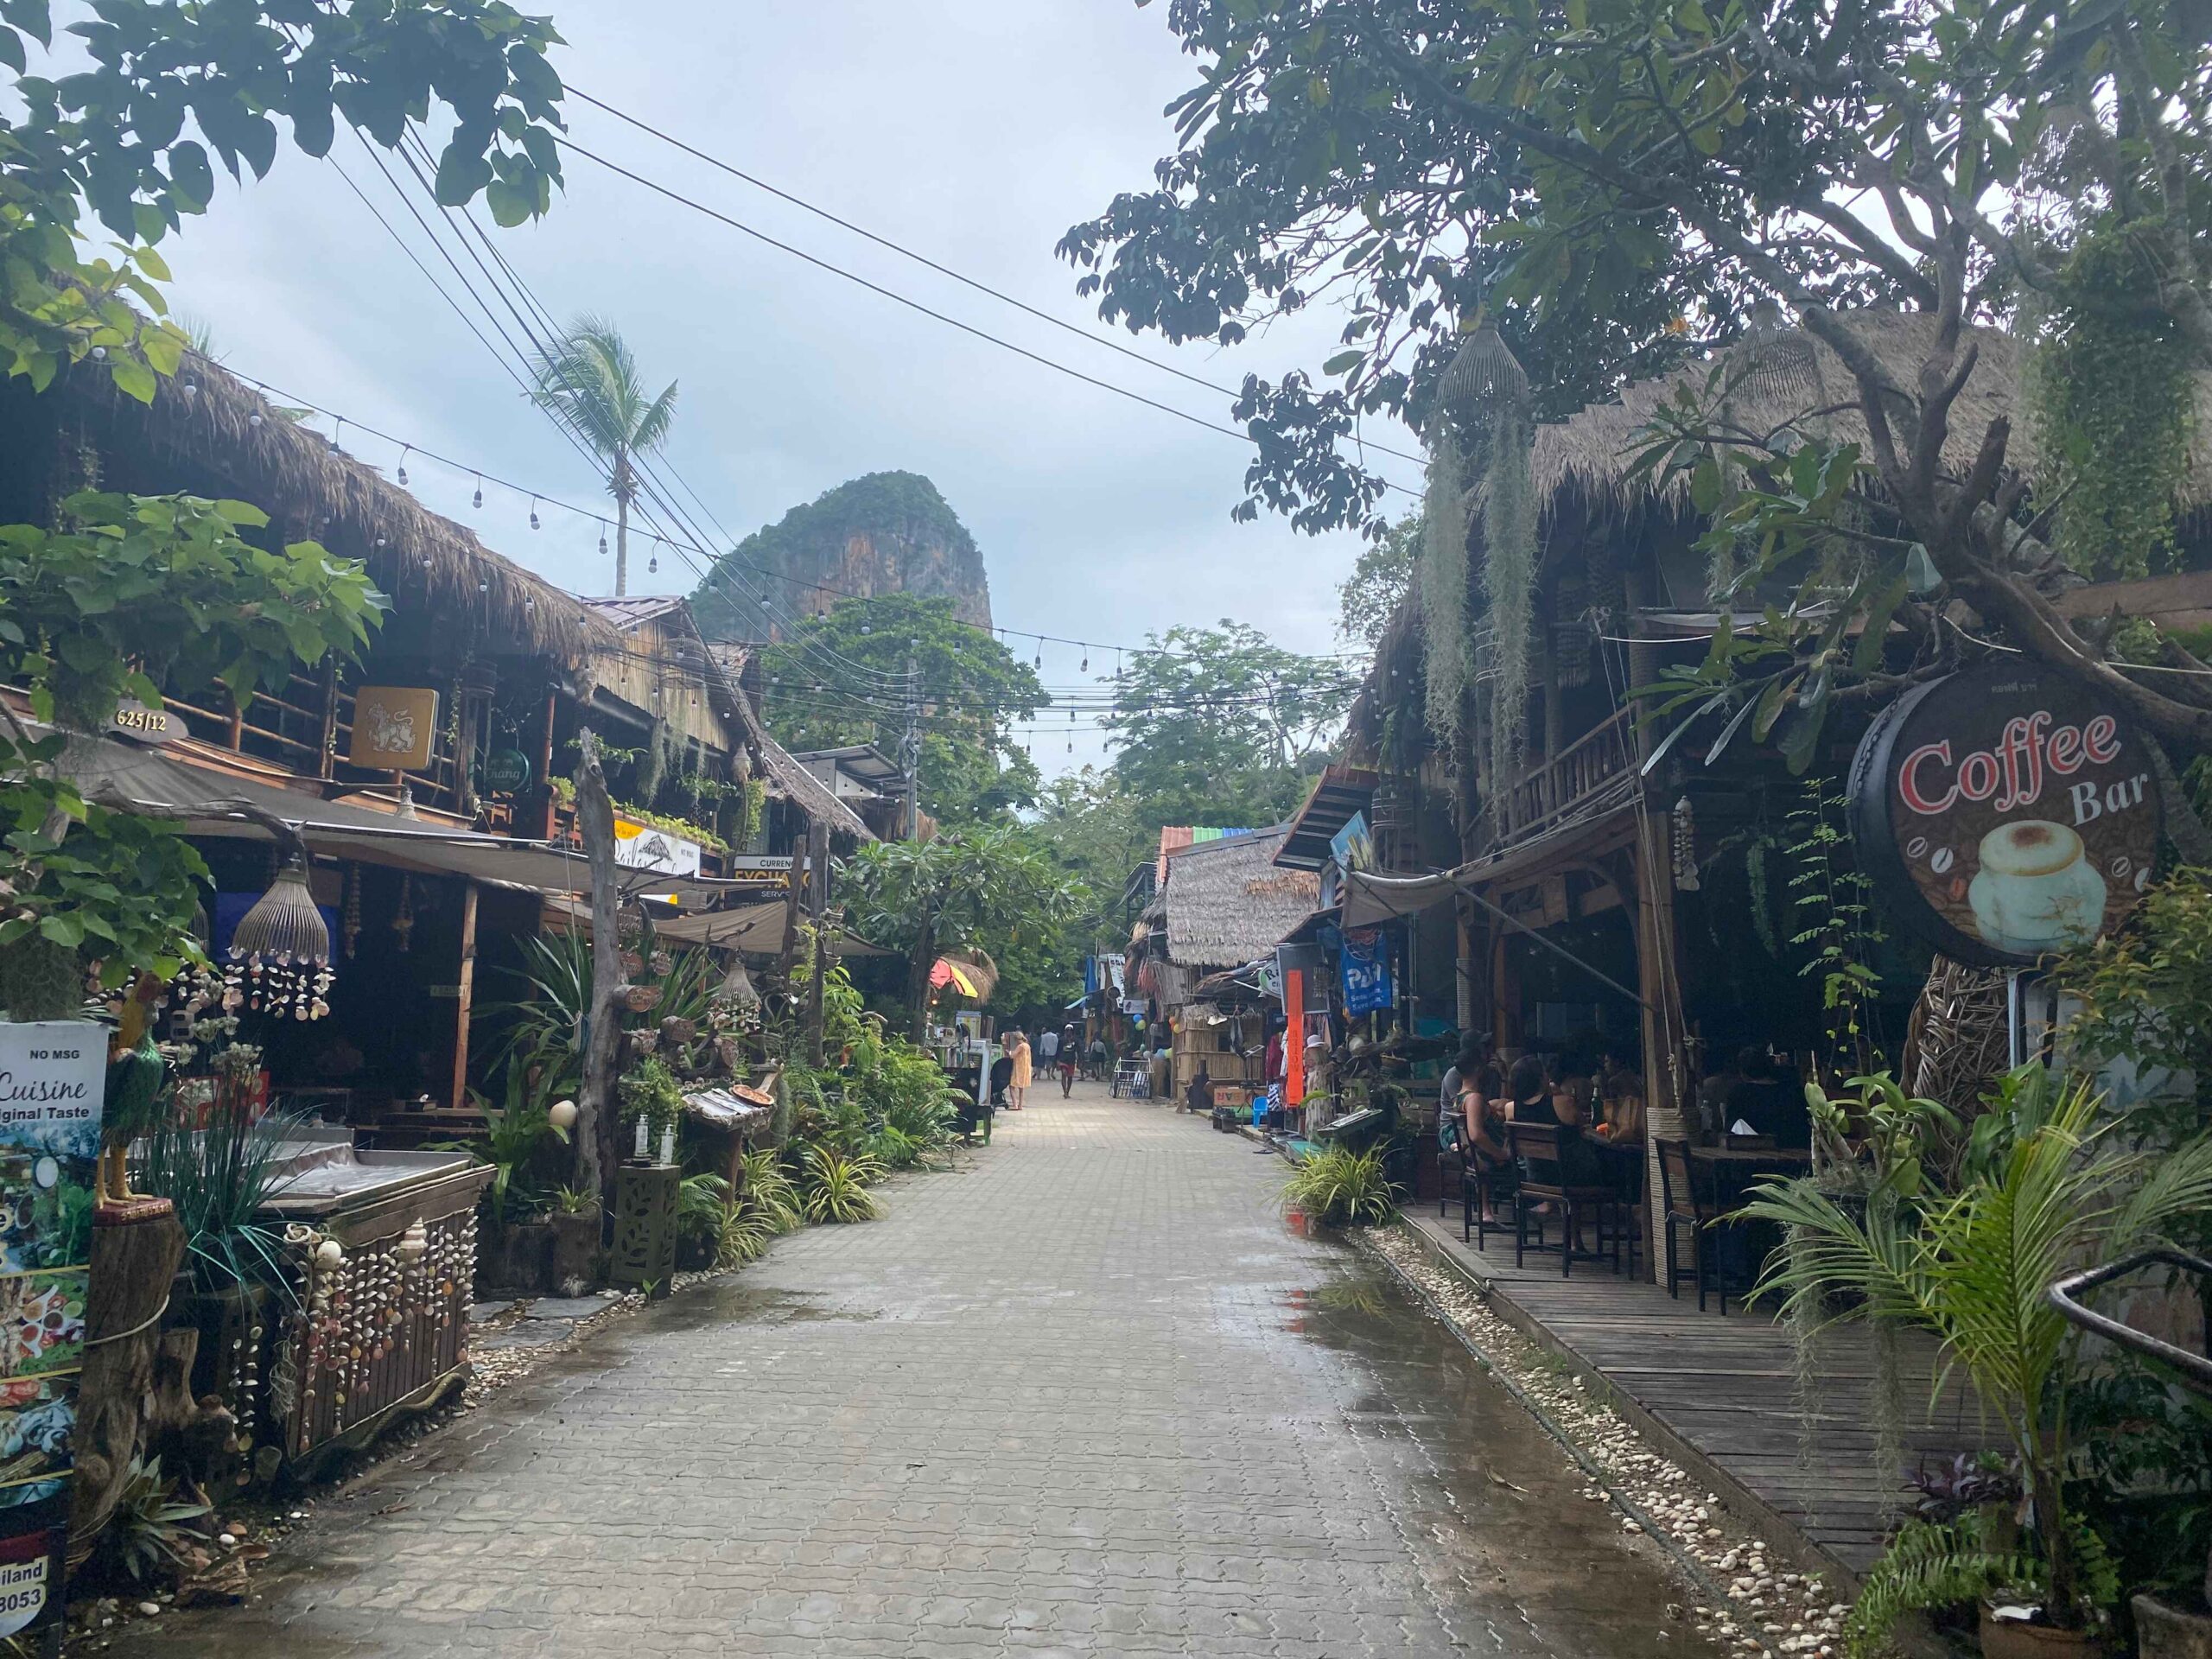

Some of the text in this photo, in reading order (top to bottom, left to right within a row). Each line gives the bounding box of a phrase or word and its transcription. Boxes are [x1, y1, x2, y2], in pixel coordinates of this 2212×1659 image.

[117, 709, 167, 732] 625/12
[1898, 710, 2122, 815] Coffee
[2067, 772, 2148, 827] Bar
[760, 859, 794, 868] CURREN
[29, 1050, 80, 1059] NO MSG
[0, 1071, 88, 1102] Cuisine
[47, 1107, 90, 1119] Taste
